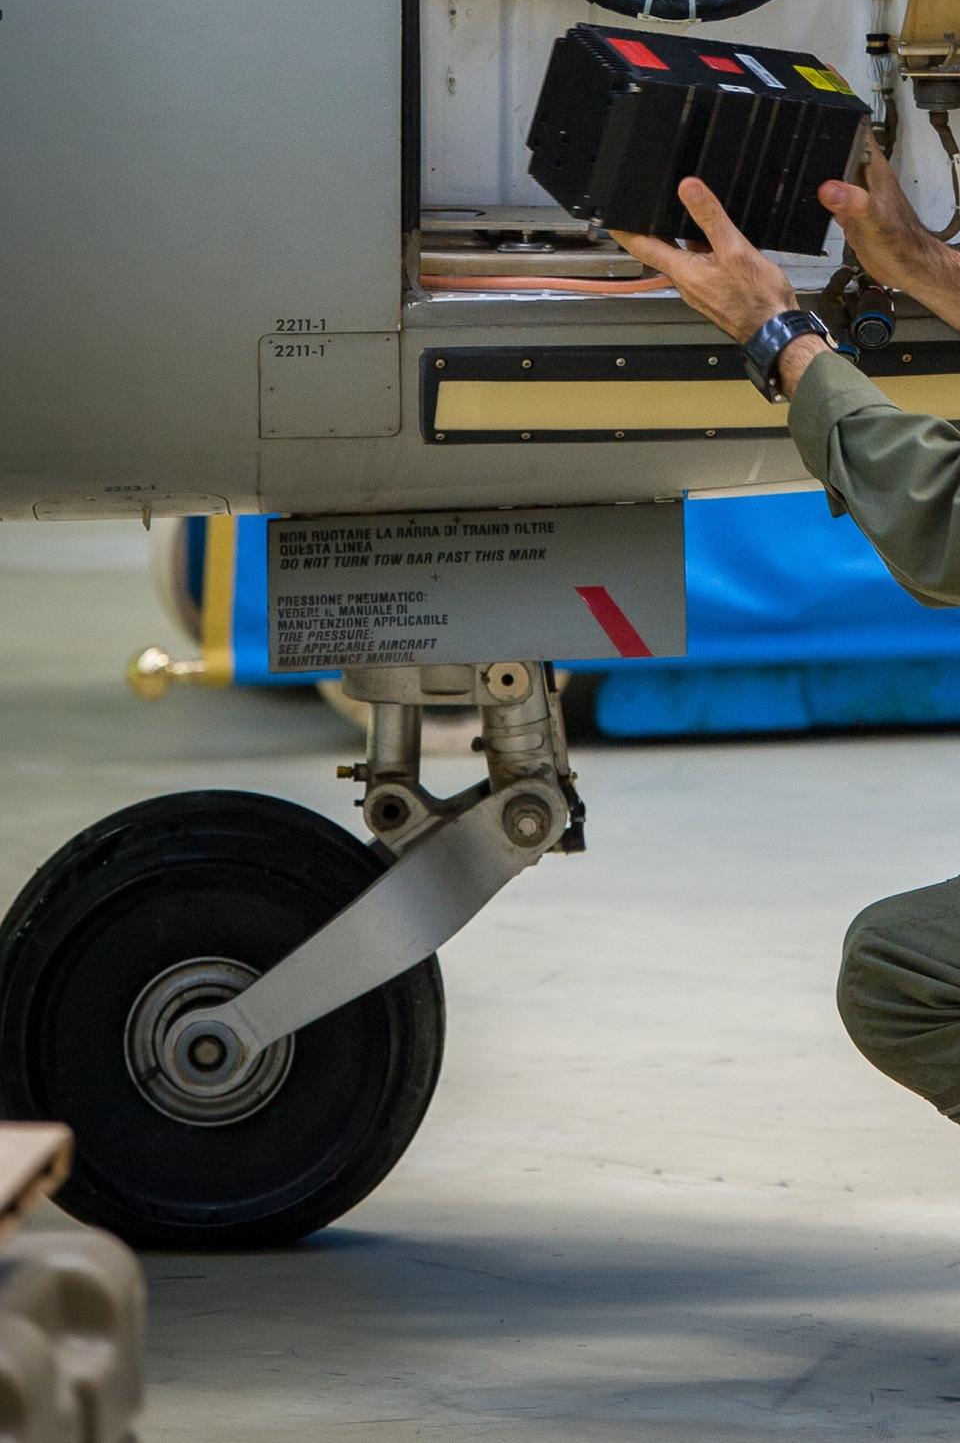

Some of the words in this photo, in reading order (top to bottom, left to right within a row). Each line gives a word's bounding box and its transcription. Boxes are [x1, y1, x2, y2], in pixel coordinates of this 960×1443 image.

[276, 319, 326, 332] 2211-1
[274, 345, 325, 357] 2211-1
[280, 531, 307, 543] NON
[311, 528, 371, 541] RUOTARE
[376, 527, 392, 539] LA
[396, 525, 440, 538] BARRA
[444, 525, 458, 537] DI
[462, 523, 510, 536] TRAINO
[514, 522, 555, 534] OLTRE
[280, 543, 331, 556] QUESTA
[335, 541, 373, 554] LINEA
[280, 558, 299, 570] DO
[303, 557, 330, 569] NOT
[334, 555, 368, 568] TURN
[374, 553, 403, 566] TOW
[406, 552, 433, 565] BAR
[437, 550, 471, 564] PAST
[474, 549, 505, 562] THIS
[508, 548, 547, 561] MARK
[278, 594, 343, 606] PRESSIONE
[347, 592, 428, 604] PNEUMATICO:
[278, 607, 320, 618] VEDERE
[325, 607, 335, 618] IL
[339, 604, 393, 616] MANUALE
[396, 603, 408, 615] DI
[278, 617, 369, 631] MANUTENZIONE
[373, 614, 449, 627] APPLICABILE
[278, 631, 303, 643] TIRE
[307, 629, 374, 641] PRESSURE:
[278, 644, 300, 655] SEE
[303, 641, 375, 654] APPLICABLE
[379, 638, 437, 651] AIRCRAFT
[278, 654, 363, 667] MAINTENANCE
[366, 651, 415, 664] MANUAL
